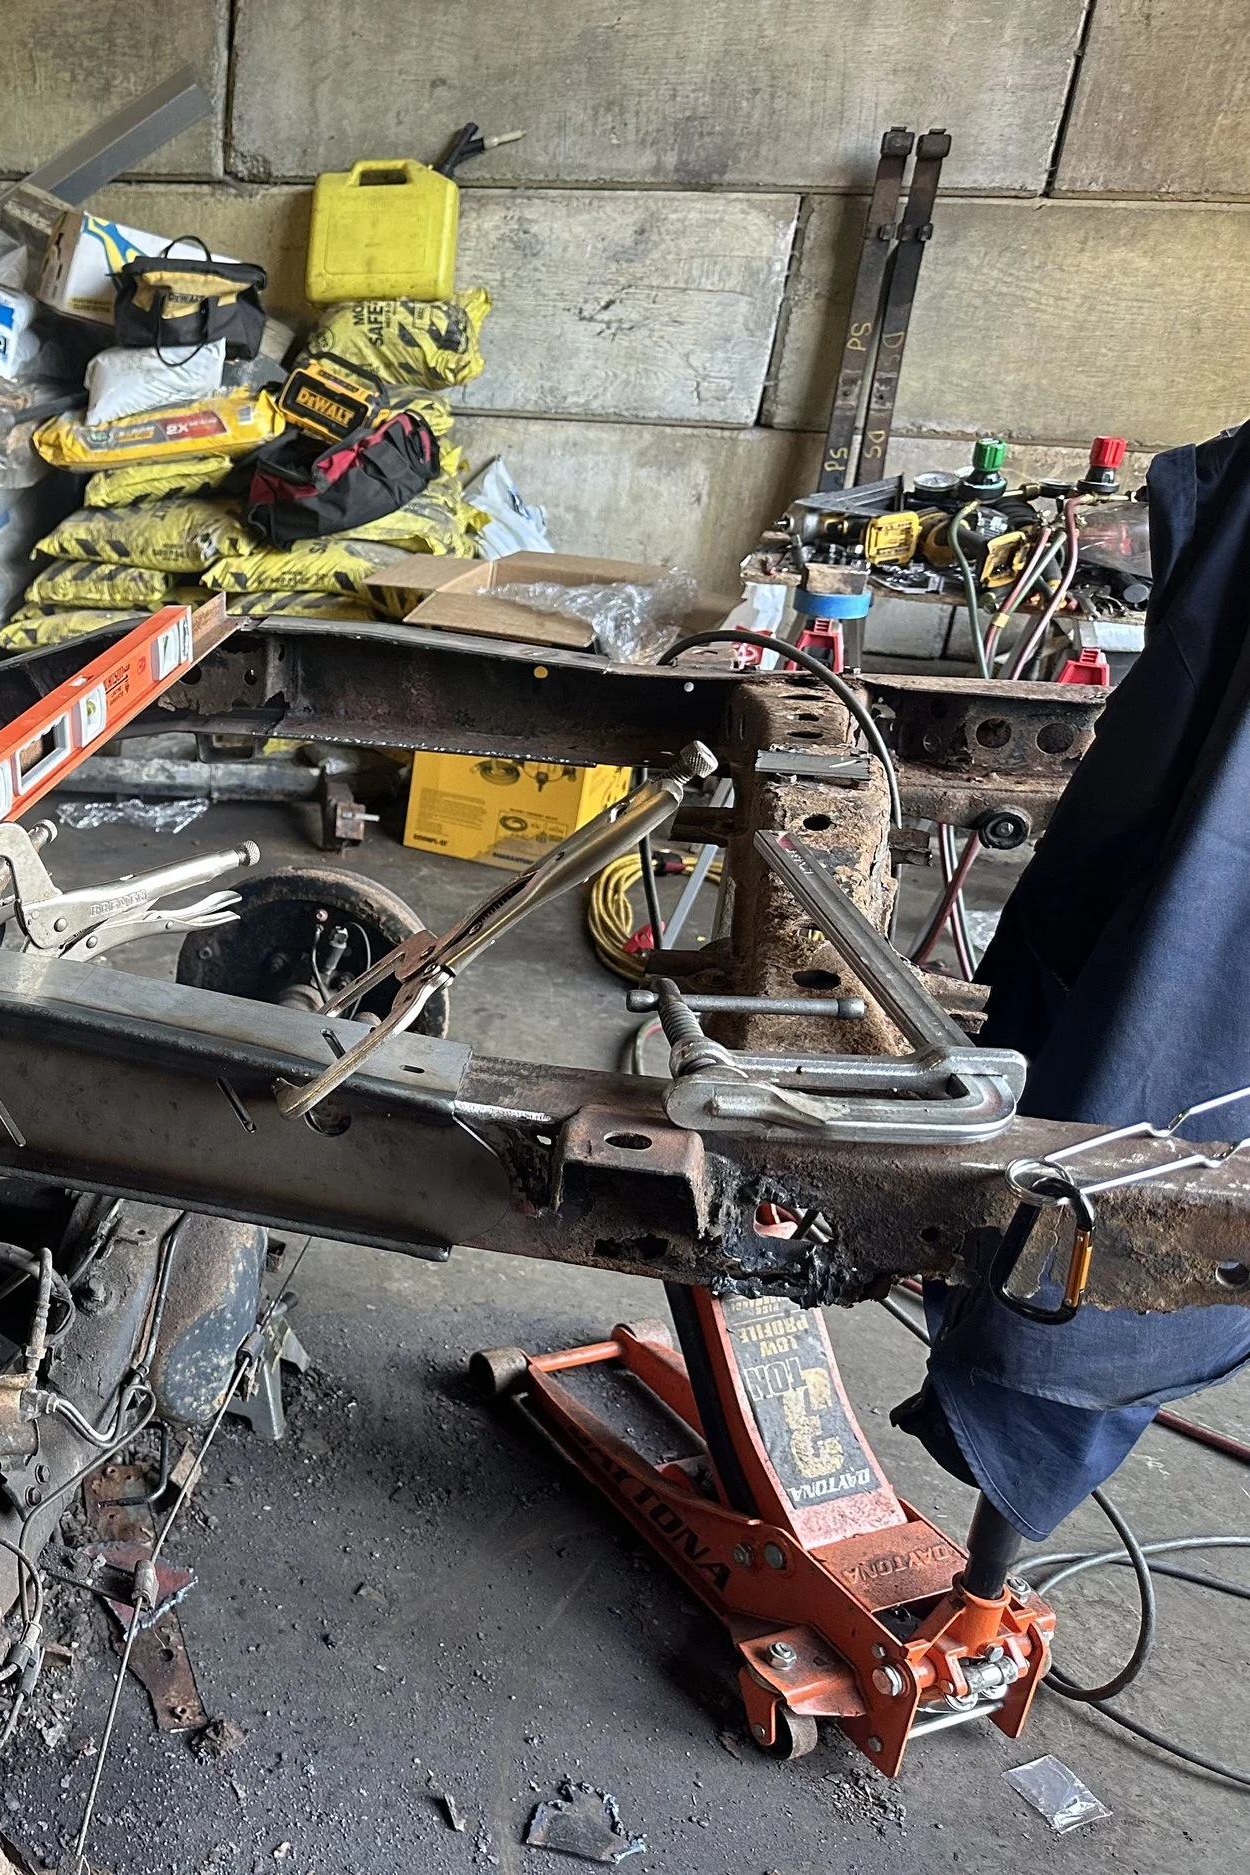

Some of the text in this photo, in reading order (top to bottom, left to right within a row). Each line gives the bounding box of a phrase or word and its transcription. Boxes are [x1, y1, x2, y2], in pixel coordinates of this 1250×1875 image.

[368, 302, 384, 347] SAFE
[847, 322, 872, 351] PS
[166, 423, 190, 436] 2X
[824, 447, 848, 471] PS
[739, 1314, 809, 1343] PROFILE
[760, 1337, 798, 1357] LOW
[744, 1357, 807, 1401] TON
[783, 1367, 846, 1478] 3
[787, 1468, 871, 1500] DAYTONA
[842, 1543, 950, 1584] DAYTONA
